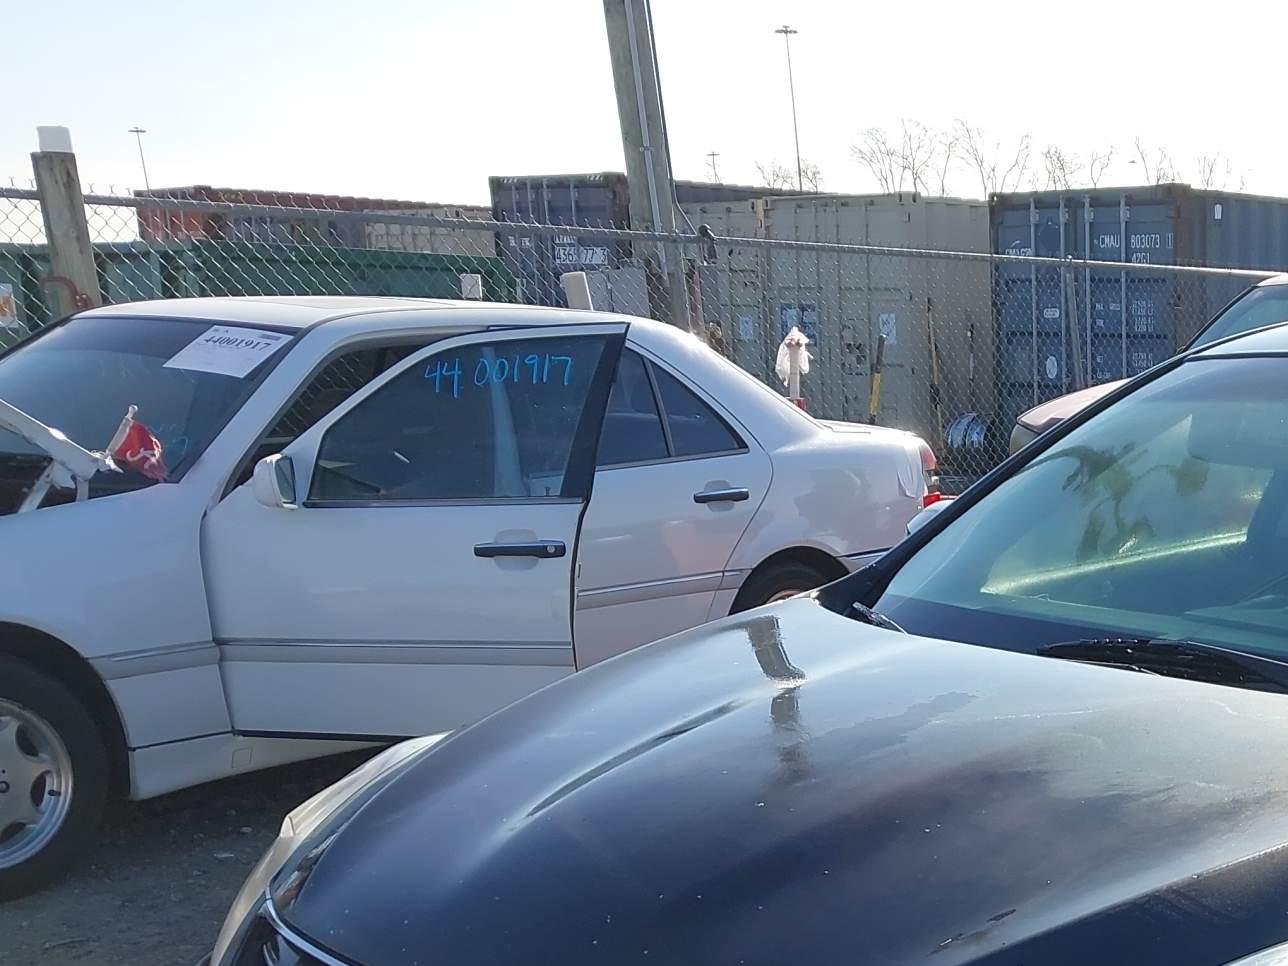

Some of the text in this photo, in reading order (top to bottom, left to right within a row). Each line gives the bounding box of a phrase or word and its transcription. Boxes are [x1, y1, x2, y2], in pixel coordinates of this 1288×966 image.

[1099, 234, 1120, 249] CMAU
[1130, 234, 1160, 249] 803073
[204, 335, 272, 351] 44001917
[424, 353, 572, 399] 44 001917
